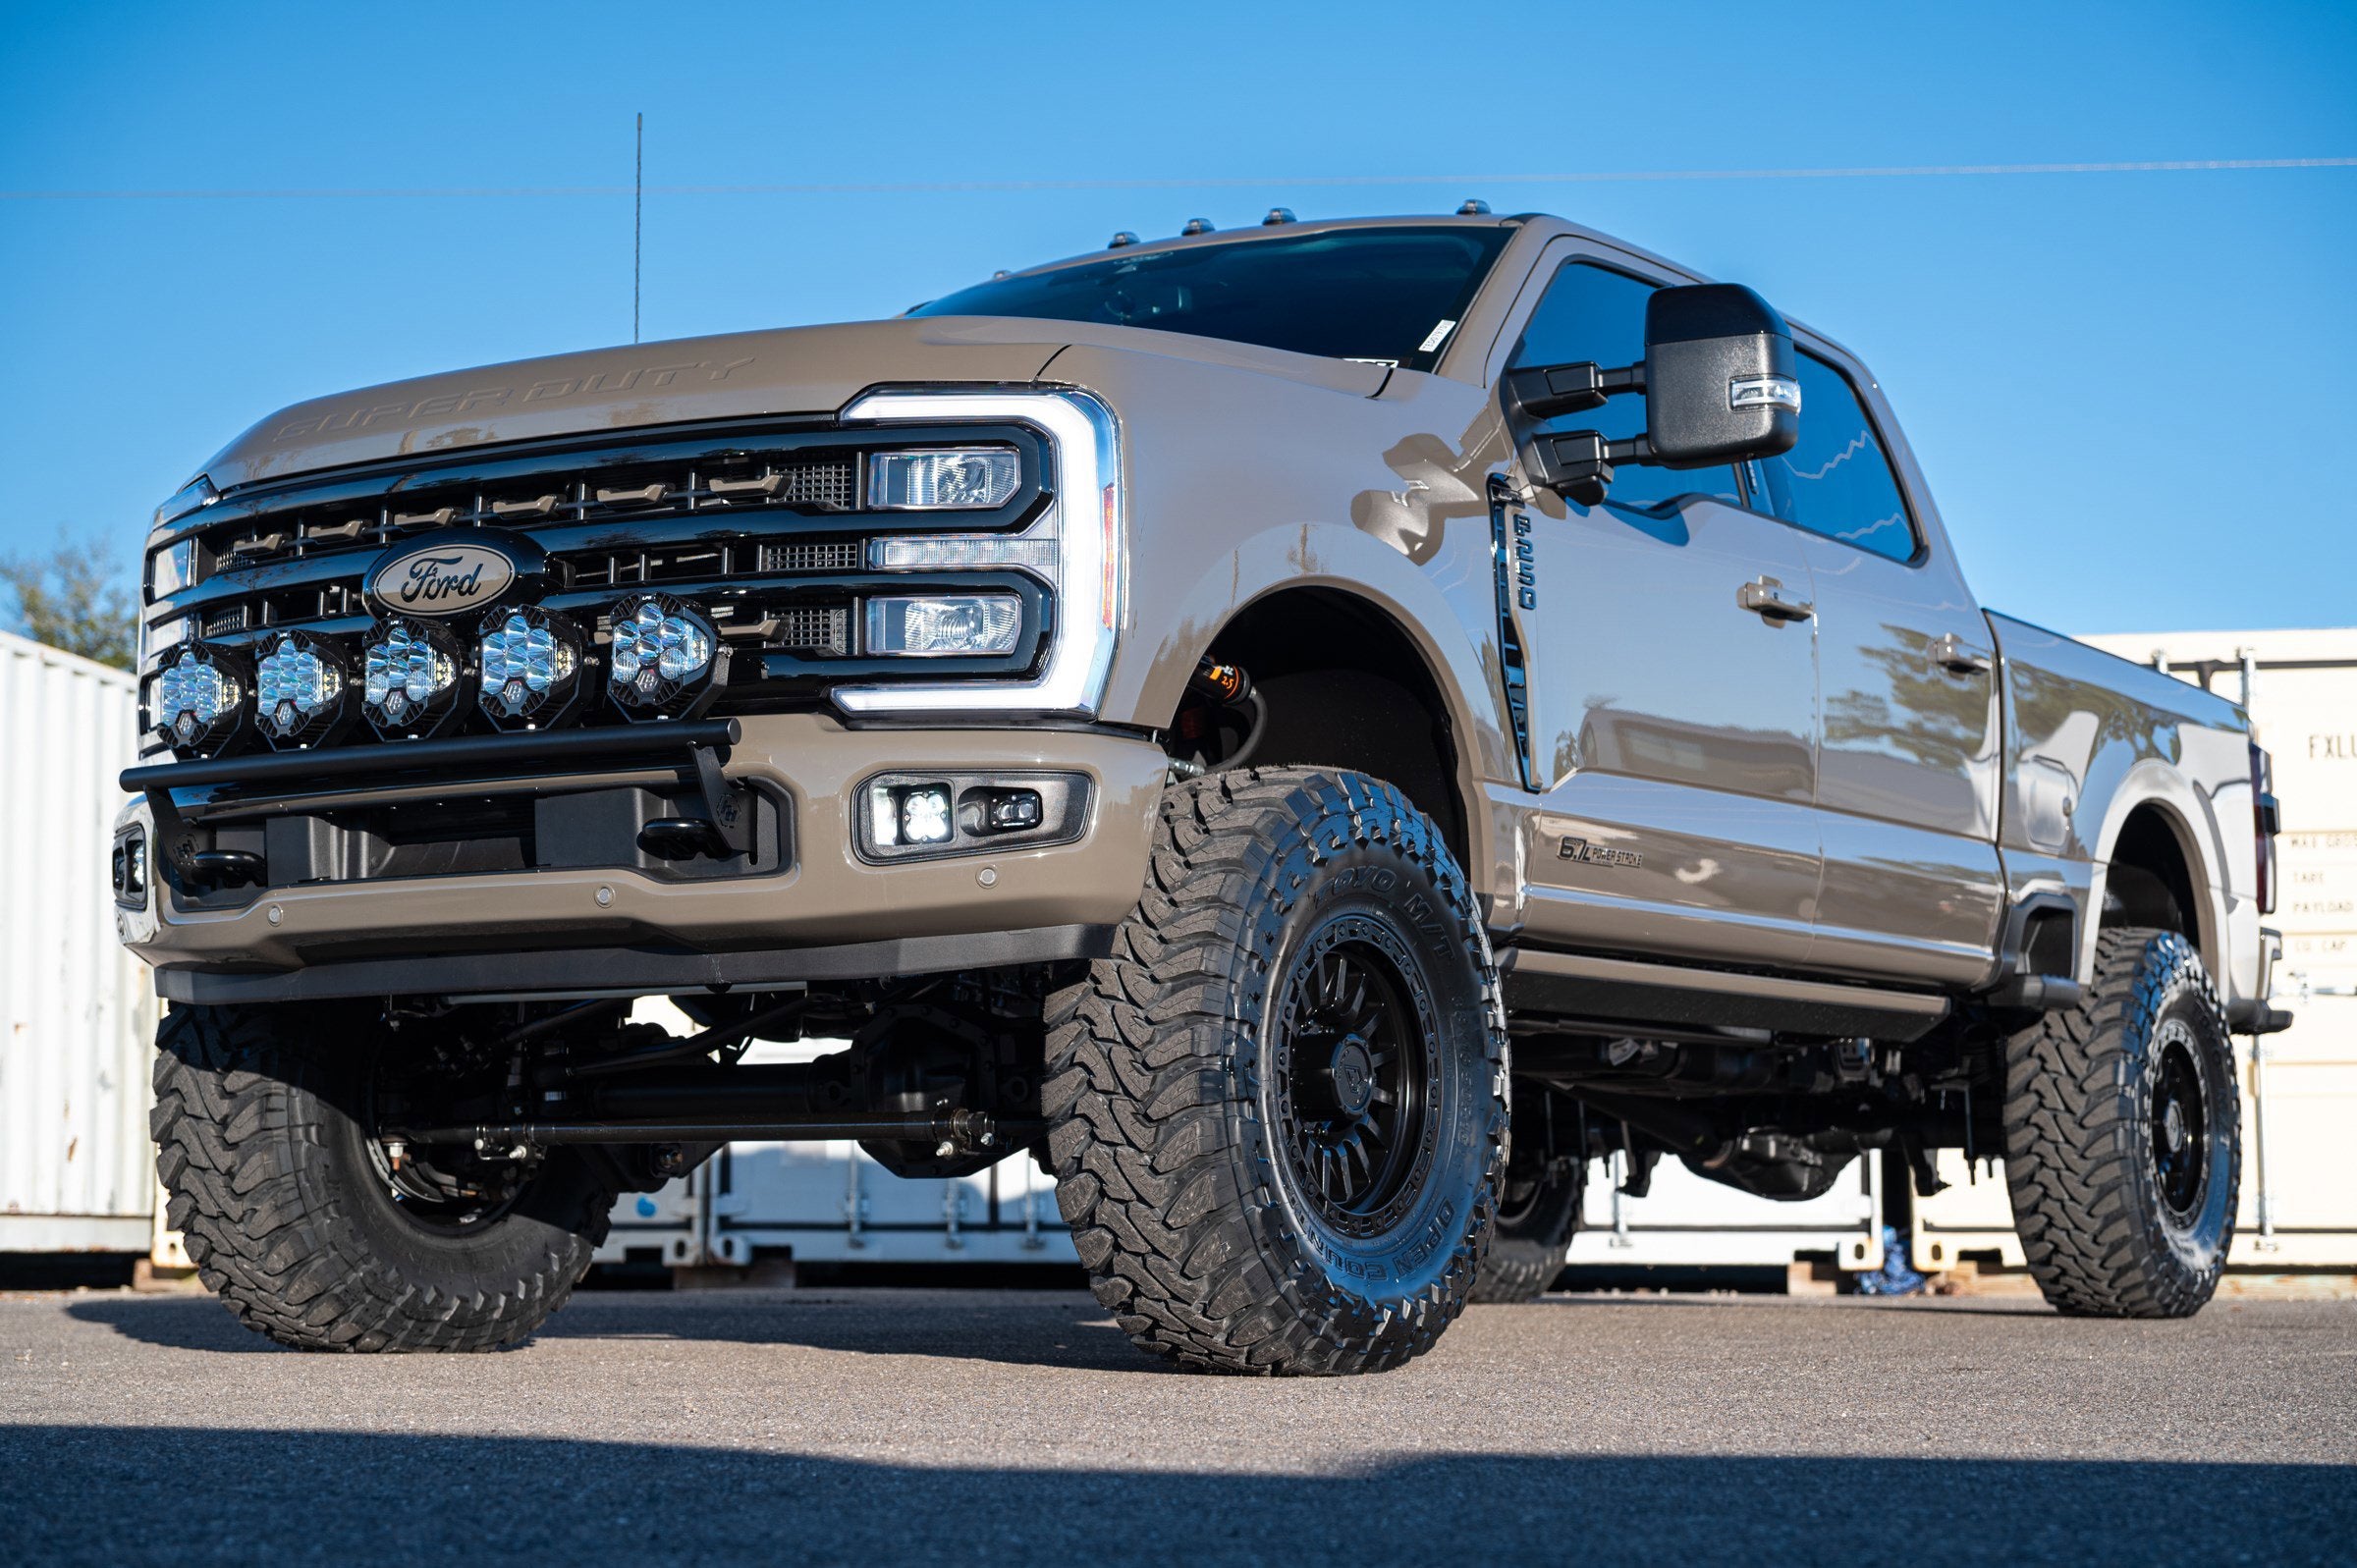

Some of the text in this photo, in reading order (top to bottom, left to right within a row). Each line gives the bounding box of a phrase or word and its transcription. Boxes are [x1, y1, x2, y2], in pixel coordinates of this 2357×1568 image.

[273, 356, 757, 443] SUPER DUTY
[401, 556, 483, 603] Ford
[1559, 836, 1642, 866] 6.7L POWER STROKE
[1403, 892, 1455, 960] M/T
[1393, 1196, 1455, 1276] OPEN
